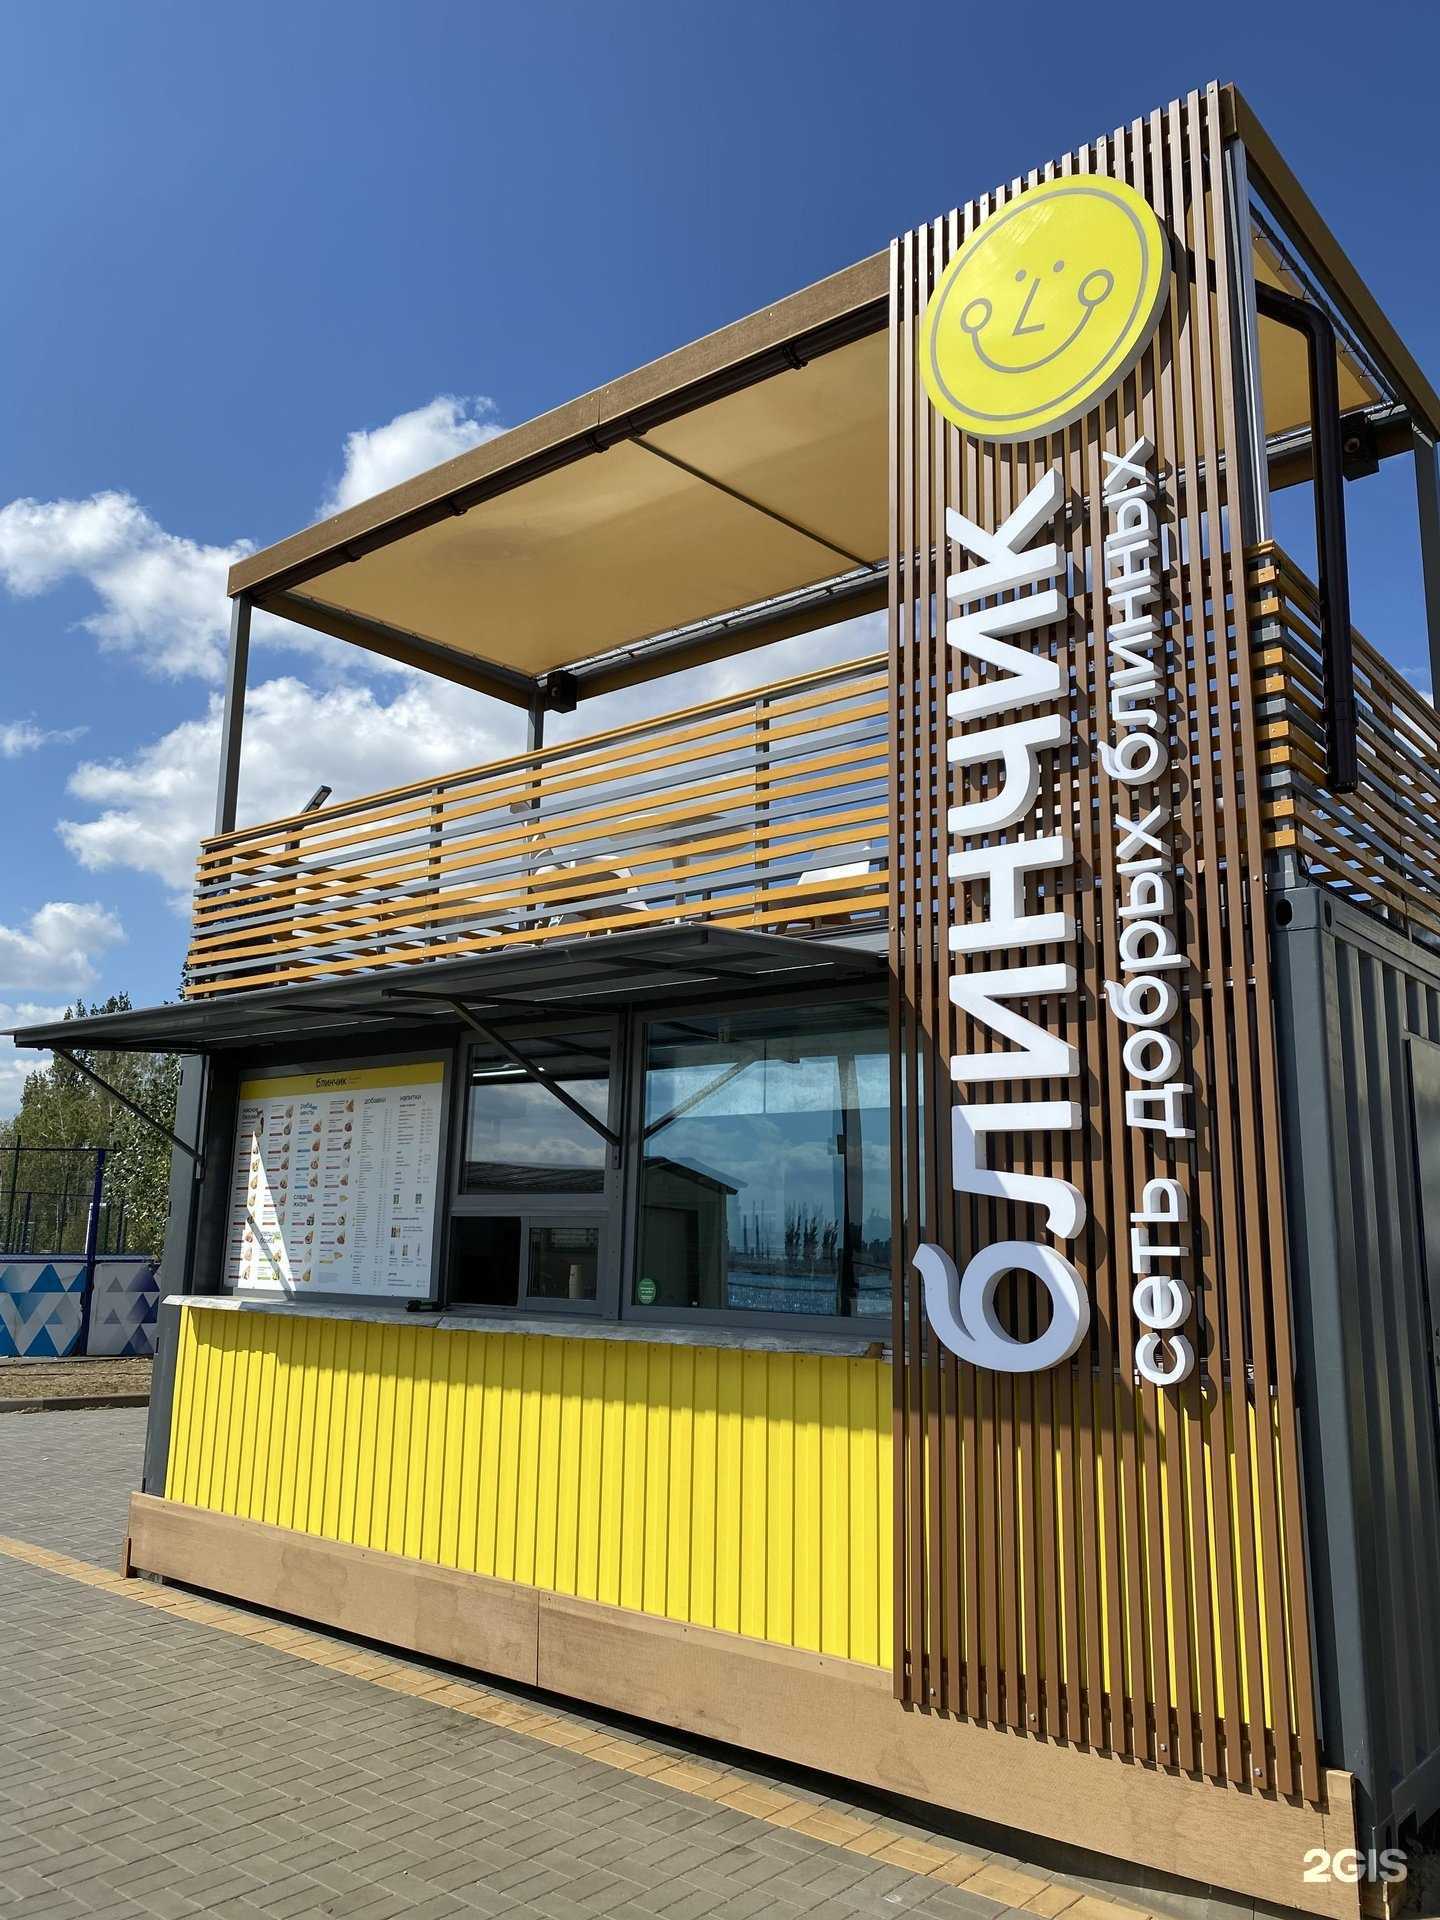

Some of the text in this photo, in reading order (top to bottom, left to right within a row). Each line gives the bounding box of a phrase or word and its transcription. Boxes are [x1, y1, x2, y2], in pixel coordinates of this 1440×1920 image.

[912, 467, 1090, 1373] блинчик
[1097, 436, 1195, 1386] сеть добрых блинных
